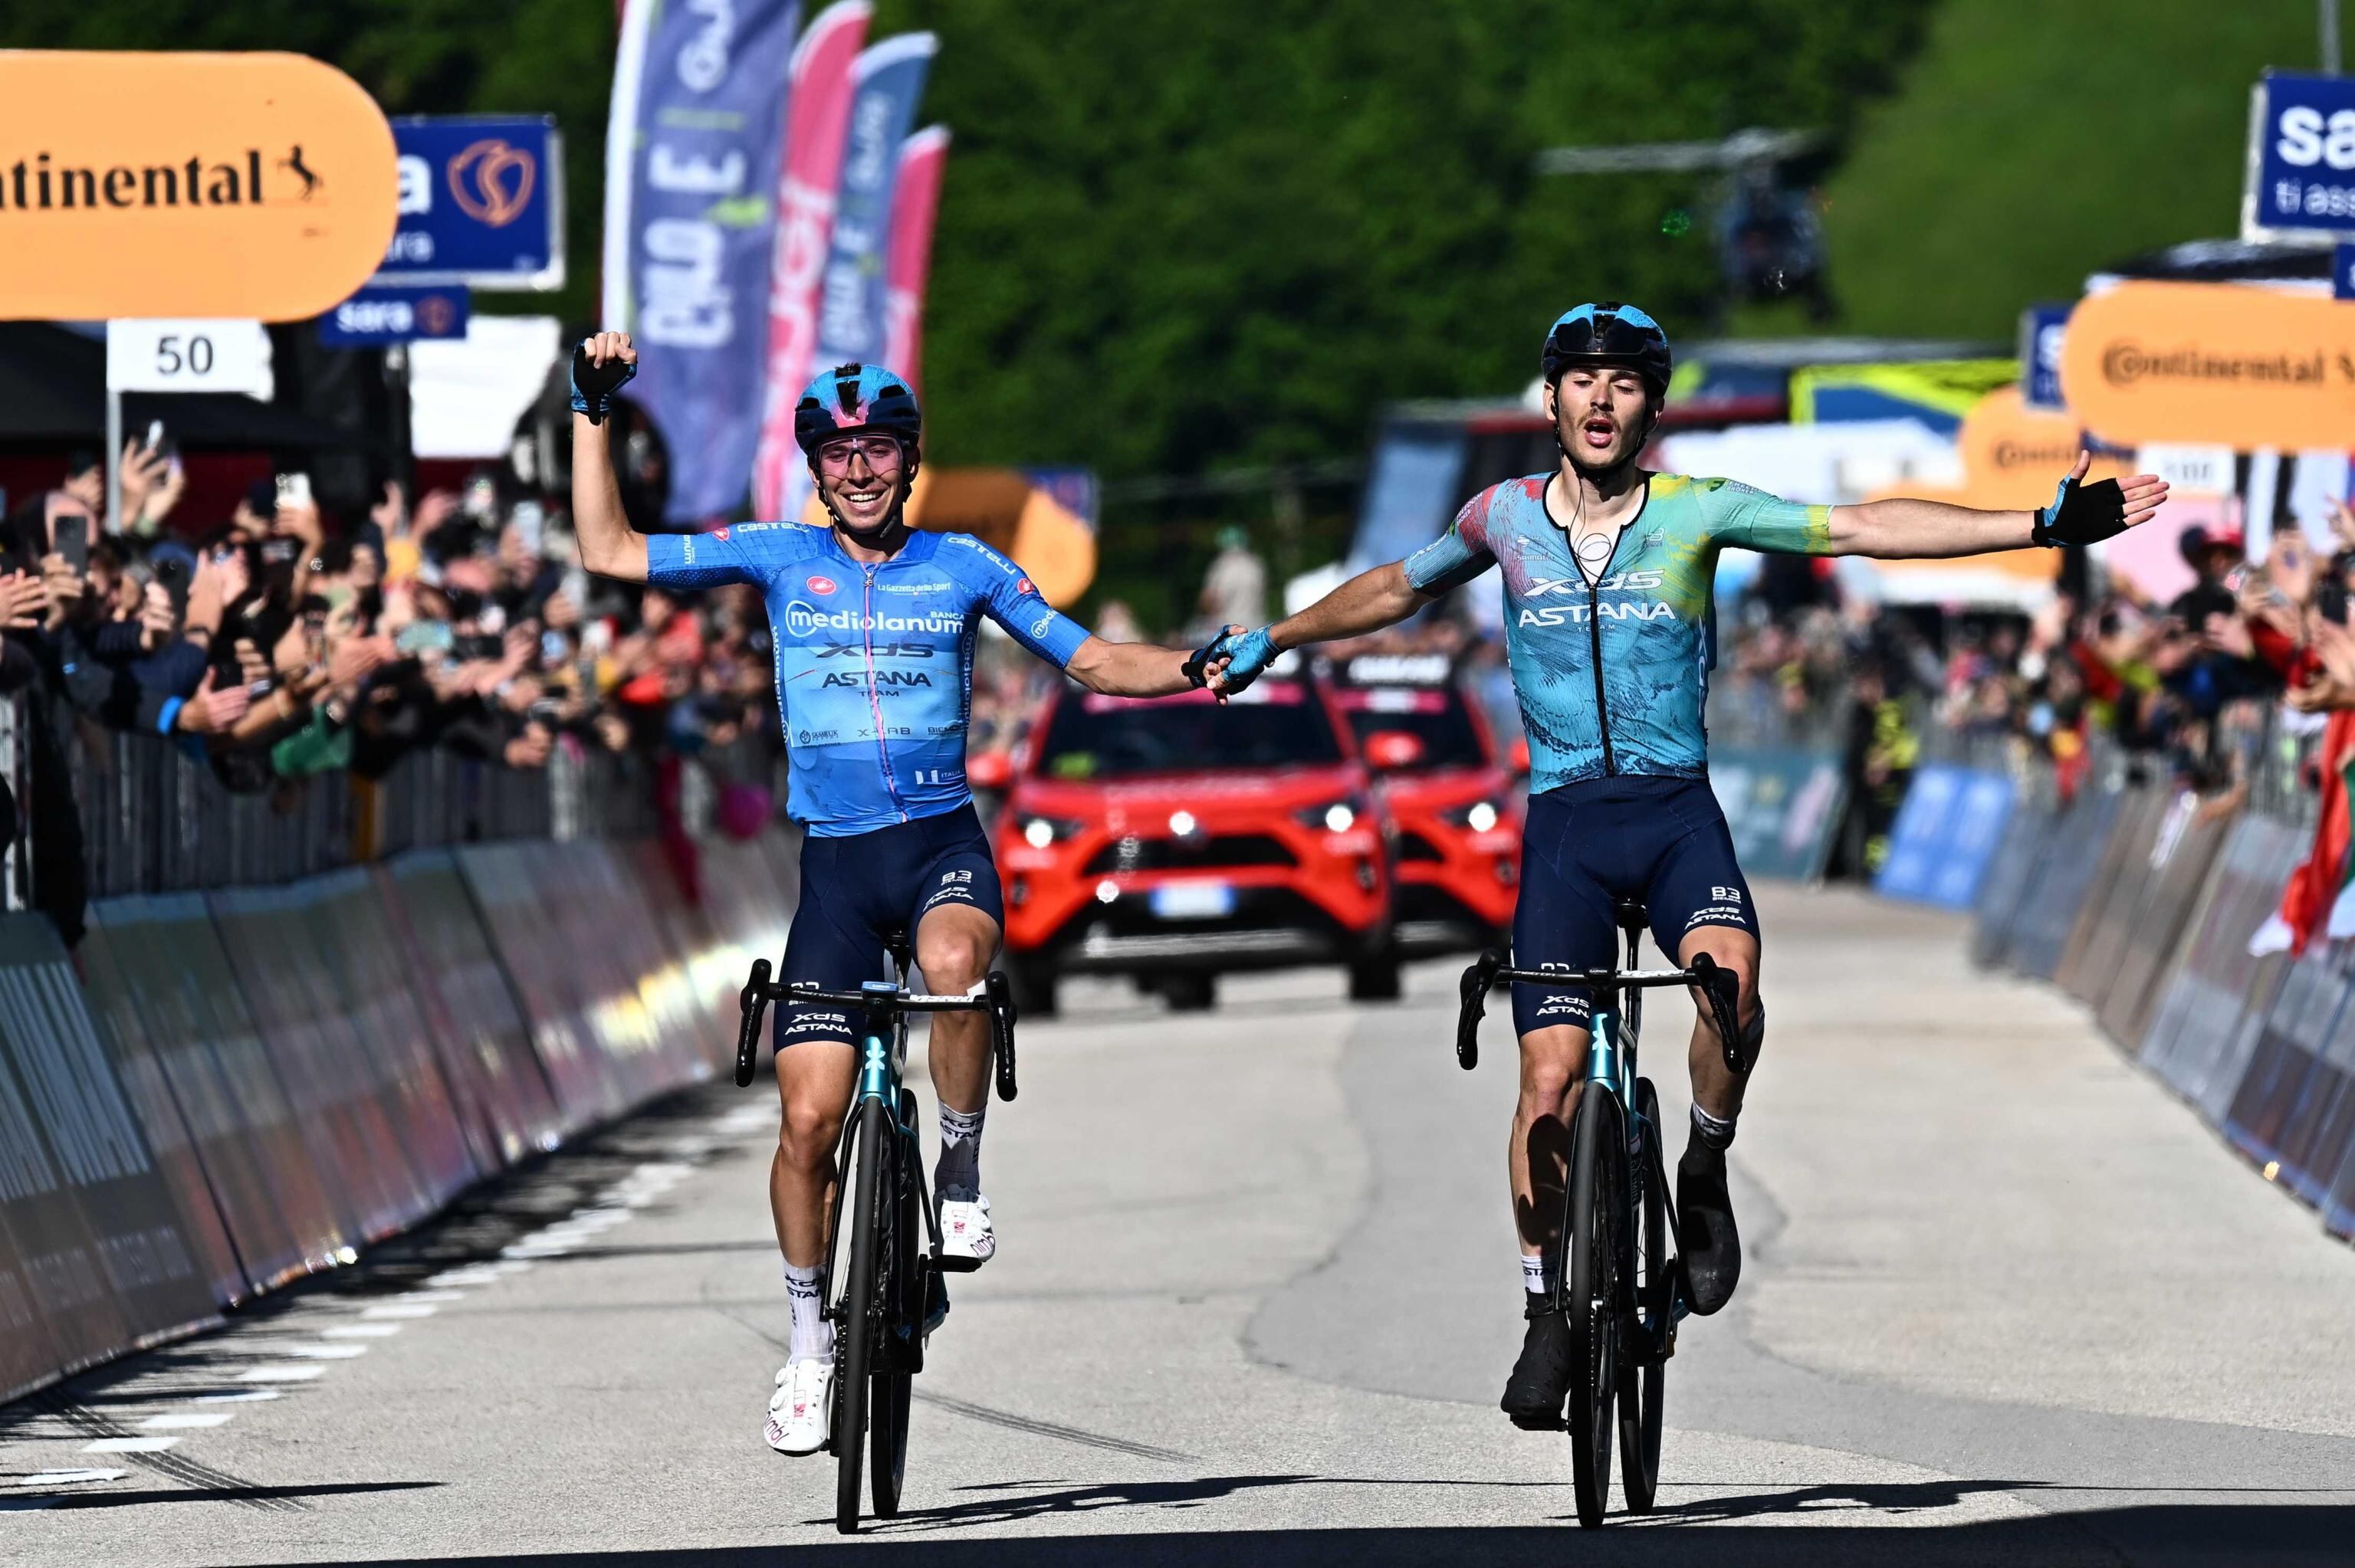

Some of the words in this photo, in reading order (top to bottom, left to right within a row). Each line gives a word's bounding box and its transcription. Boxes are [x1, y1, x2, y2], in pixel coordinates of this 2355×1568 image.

[0, 150, 261, 212] tinental
[158, 336, 213, 374] 50
[932, 582, 951, 592] Sport
[786, 606, 964, 635] mediolanum
[931, 611, 964, 620] BANCA
[1519, 602, 1676, 628] ASTANA
[822, 671, 932, 688] ASTANA
[1711, 886, 1741, 900] B3
[1685, 914, 1746, 930] ASTANA
[1536, 1005, 1589, 1019] ASTAN
[784, 1023, 852, 1035] ASTANA
